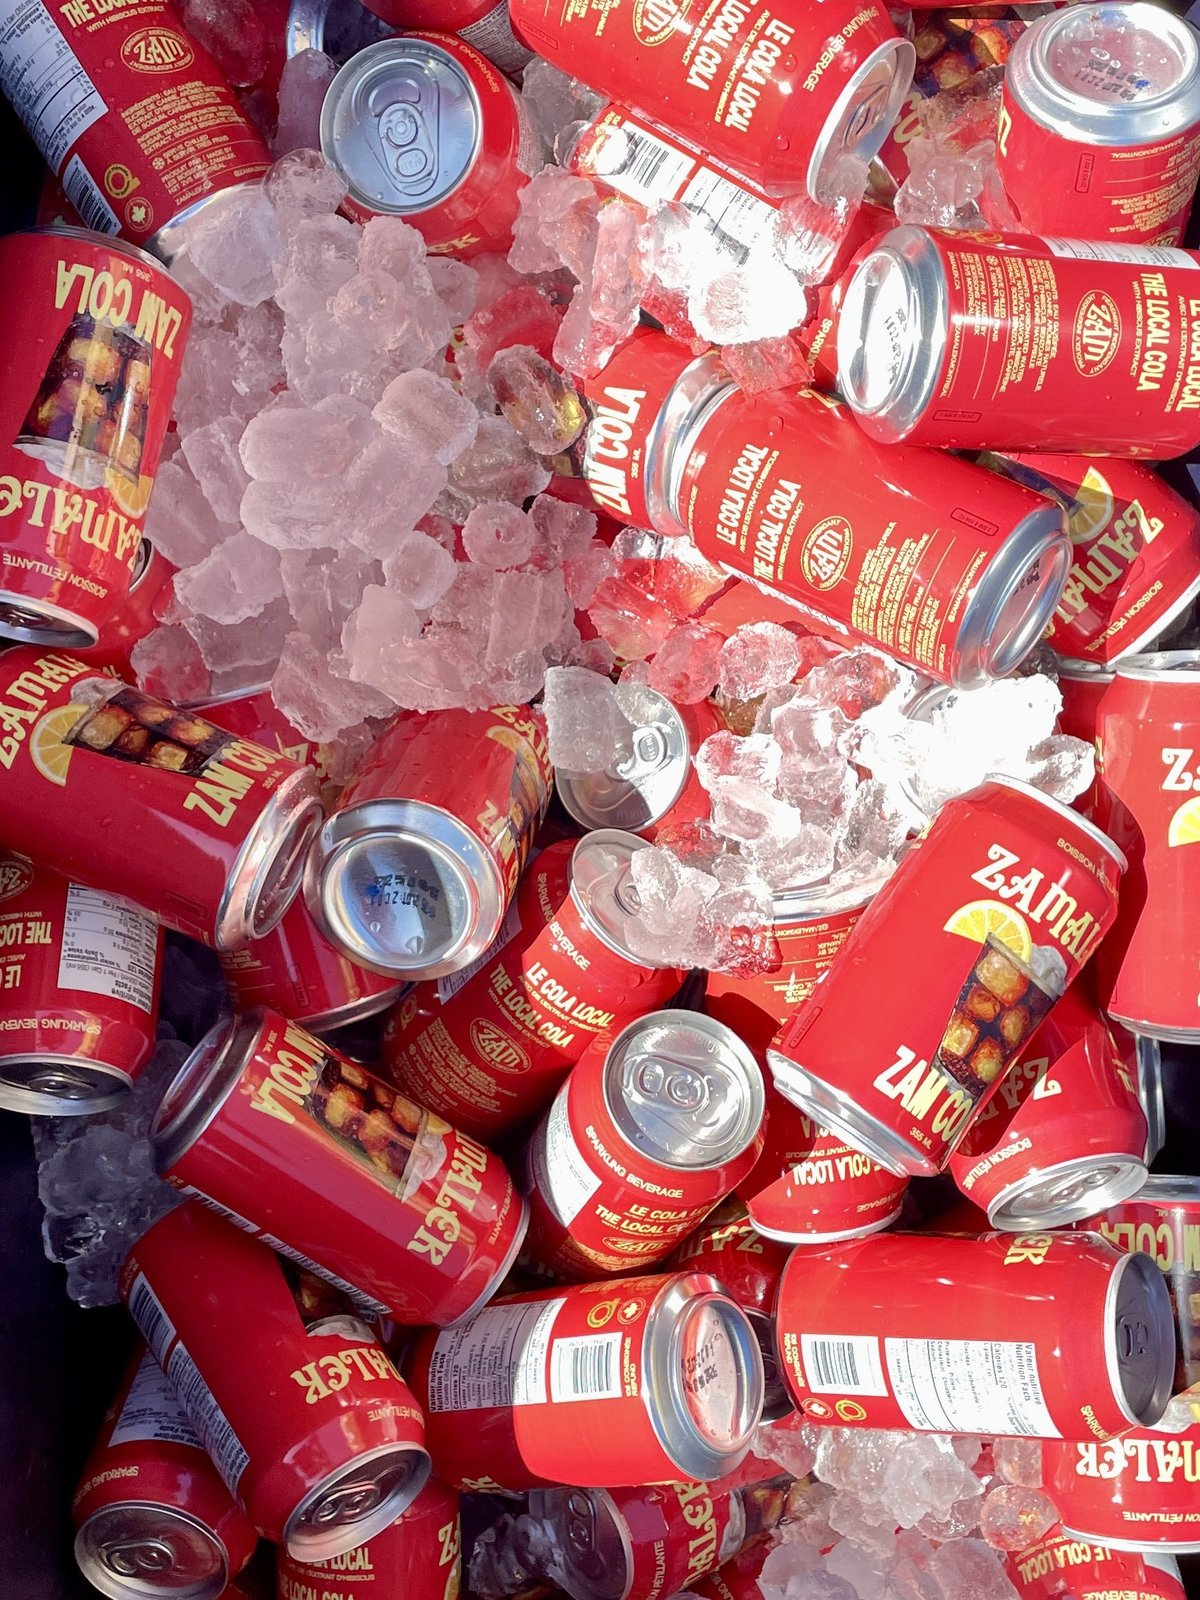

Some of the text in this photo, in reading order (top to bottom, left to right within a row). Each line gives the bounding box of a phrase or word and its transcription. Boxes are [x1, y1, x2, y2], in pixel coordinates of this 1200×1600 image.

[86, 19, 106, 32] WITH
[746, 30, 756, 42] DE
[754, 10, 770, 30] AVEC
[843, 7, 876, 37] SPARKLING
[133, 34, 184, 66] ZAM
[803, 35, 846, 91] BEVERAGE
[459, 46, 500, 92] SPARKLING
[687, 46, 721, 90] COLA
[725, 19, 794, 132] LE COLA LOCAL
[119, 260, 152, 282] 355 ML
[978, 280, 986, 295] PAR
[997, 288, 1005, 320] CHILLED
[1132, 281, 1141, 300] WITH
[1178, 295, 1186, 317] AVEC
[55, 261, 181, 359] ZAM COLA
[1021, 301, 1030, 353] CARBONATED
[1180, 316, 1187, 327] DE
[978, 325, 987, 336] BY
[1009, 279, 1024, 382] NATURAL HIBISCUS
[1034, 326, 1045, 366] BENZOATE
[1083, 301, 1114, 361] ZAM
[1137, 273, 1170, 390] THE LOCAL COLA
[1130, 336, 1142, 377] EXTRACT
[999, 359, 1013, 392] CAFFEINE
[585, 387, 646, 515] ZAM COLA
[630, 447, 641, 479] 355 ML
[717, 444, 769, 545] LE COLA LOCAL
[755, 480, 801, 563] LOCAL COLA
[787, 500, 804, 535] EXTRACT
[753, 556, 774, 583] THE
[806, 530, 846, 580] ZAM
[3, 554, 107, 598] BOISSON PÉTILLANTE
[926, 593, 934, 605] BY
[1125, 581, 1163, 618] BOISSON
[183, 759, 254, 826] ZAM
[1057, 838, 1099, 873] BOISSON
[971, 844, 1099, 958] ZAMAL
[25, 922, 52, 944] THE
[549, 922, 590, 970] BEVERAGE
[5, 965, 21, 988] LE
[526, 960, 614, 1027] LE COLA LOCAL
[490, 963, 574, 1047] THE LOCAL COLA
[41, 1019, 101, 1036] SPARKLING
[263, 1041, 273, 1053] ML
[476, 1029, 520, 1071] ZAM
[250, 1051, 317, 1125] COLA
[873, 1045, 949, 1120] ZAM
[909, 1126, 933, 1150] 355 ML
[989, 1138, 1032, 1167] BOISSON
[586, 1126, 683, 1198] SPARKLING BEVERAGE
[793, 1152, 873, 1185] COLA LOCAL
[407, 1131, 486, 1265] MALEK
[627, 1203, 687, 1220] LE COLA
[596, 1205, 663, 1236] THE LOCAL
[784, 1333, 793, 1363] REFUND
[993, 1342, 1008, 1388] Calories 120
[1014, 1342, 1029, 1379] Nutrition
[1025, 1344, 1037, 1372] Valeur
[451, 1363, 461, 1410] Calories 120
[628, 1362, 638, 1396] REFUND
[428, 1384, 438, 1412] Valeur
[92, 1466, 139, 1486] SPARKLING
[1121, 1510, 1183, 1524] PÉTILLANTE
[653, 1540, 665, 1590] PÉTILLANTE
[1018, 1550, 1054, 1584] LOCAL
[1054, 1541, 1091, 1567] COLA
